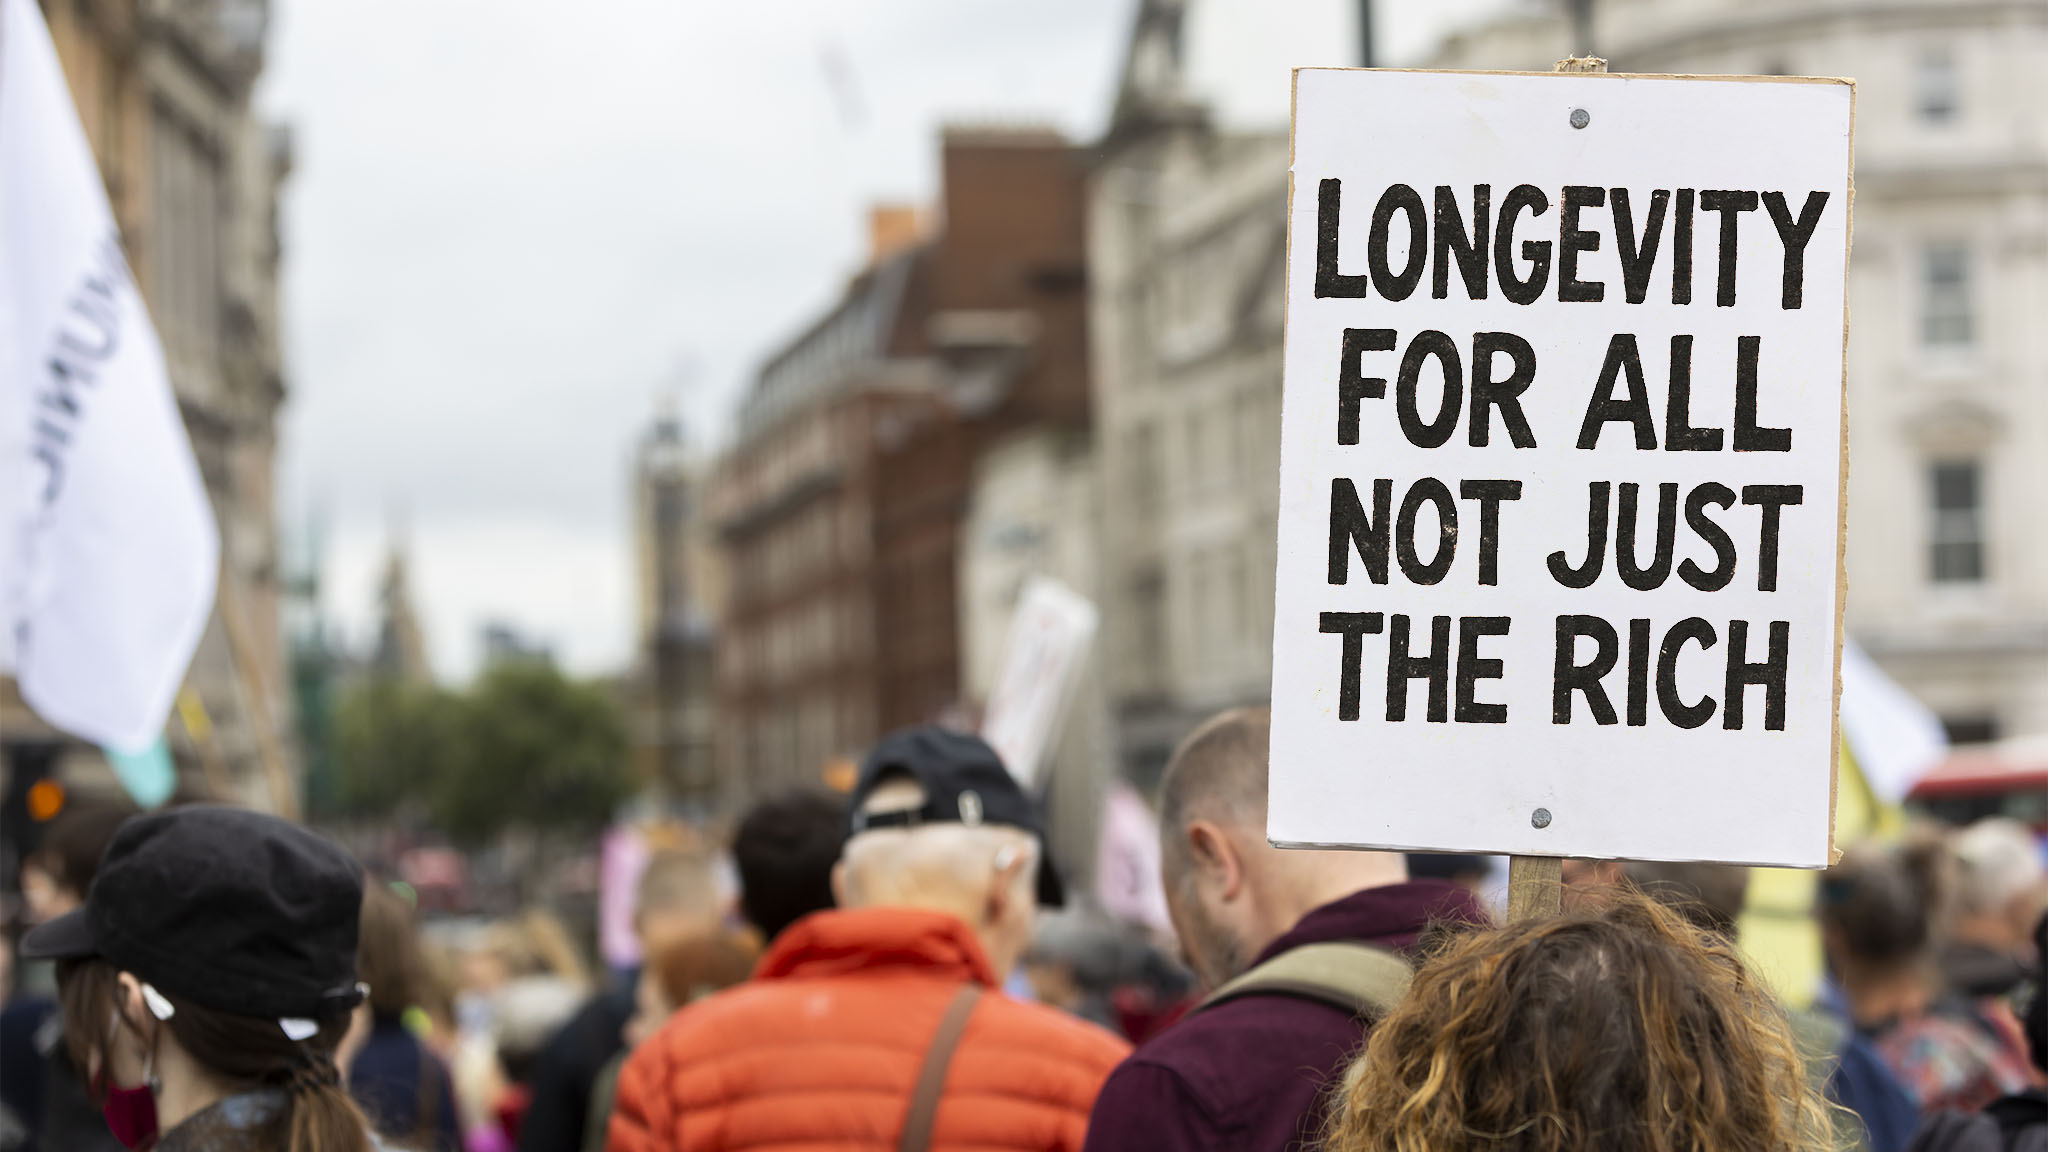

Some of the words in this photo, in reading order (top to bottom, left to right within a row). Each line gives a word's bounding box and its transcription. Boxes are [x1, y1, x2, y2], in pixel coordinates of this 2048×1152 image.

[1314, 177, 1831, 311] LONGEVITY
[1337, 327, 1538, 450] FOR
[1575, 333, 1793, 453] ALL
[1327, 476, 1523, 587] NOT
[1546, 480, 1804, 593] JUST
[1318, 611, 1512, 724] THE
[1551, 614, 1790, 732] RICH
